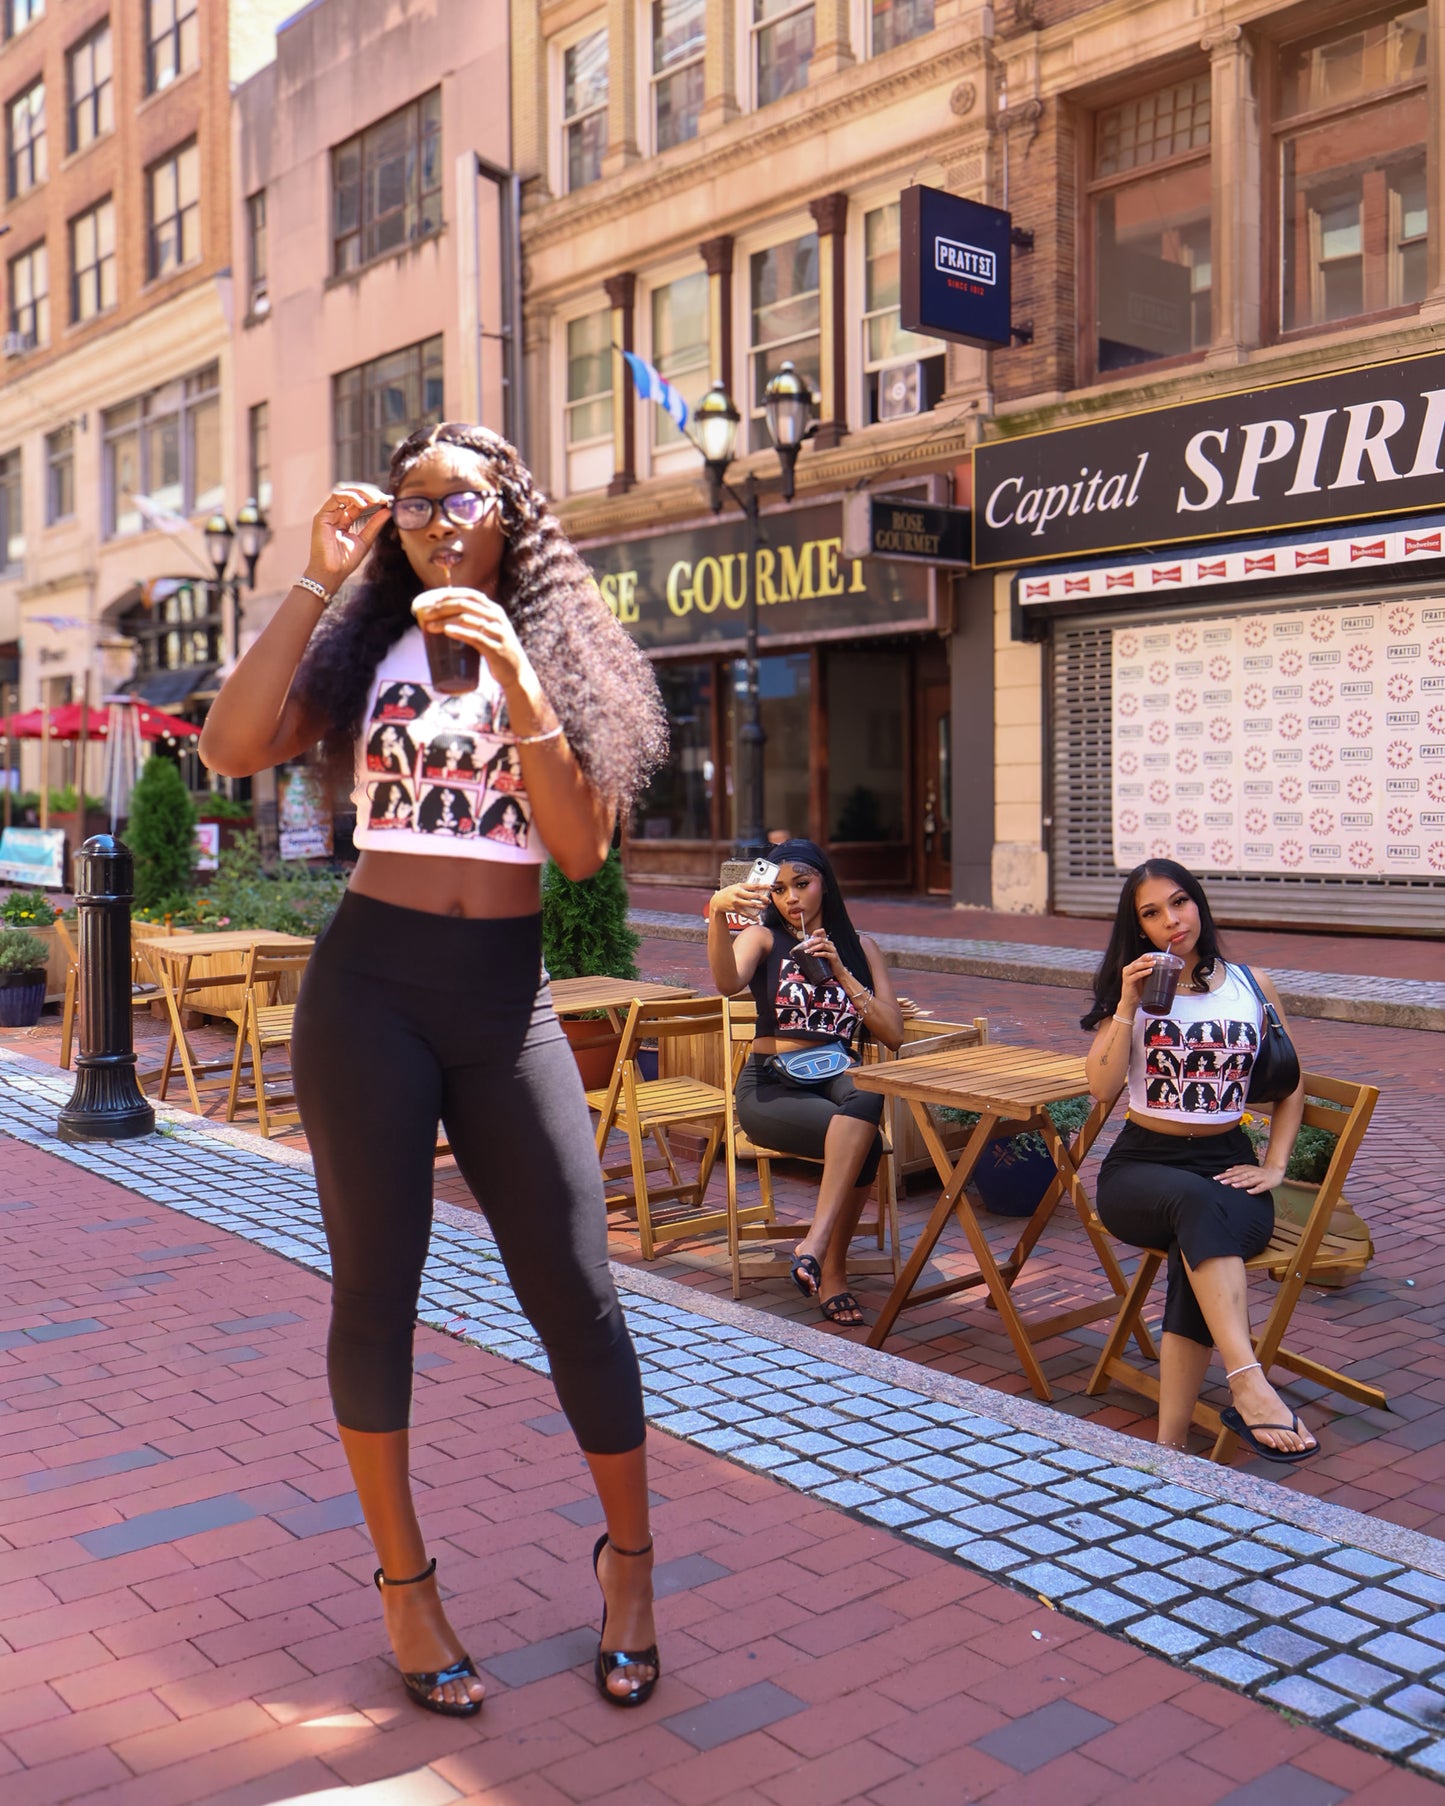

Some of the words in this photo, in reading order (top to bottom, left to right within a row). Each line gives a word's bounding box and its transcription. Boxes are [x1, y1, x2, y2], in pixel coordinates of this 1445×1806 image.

[940, 245, 977, 273] PRATT
[946, 278, 968, 292] SINCE
[985, 452, 1149, 536] Capital
[1176, 388, 1445, 513] SPIRI
[892, 511, 925, 533] ROSE
[875, 529, 940, 554] GOURMET
[588, 570, 640, 624] SE
[1388, 606, 1414, 620] STELLA
[1388, 622, 1414, 636] ARTOIS
[1390, 647, 1410, 656] PRATT
[1387, 673, 1413, 686] STELLA
[1388, 690, 1413, 703] ARTOIS
[1389, 714, 1409, 723] PRATT
[1387, 740, 1412, 753] STELLA
[1387, 757, 1413, 770] ARTOIS
[1389, 781, 1409, 789] PRATT
[1387, 807, 1412, 820] STELLA
[1387, 823, 1413, 836] ARTOIS
[1389, 847, 1409, 856] PRATT
